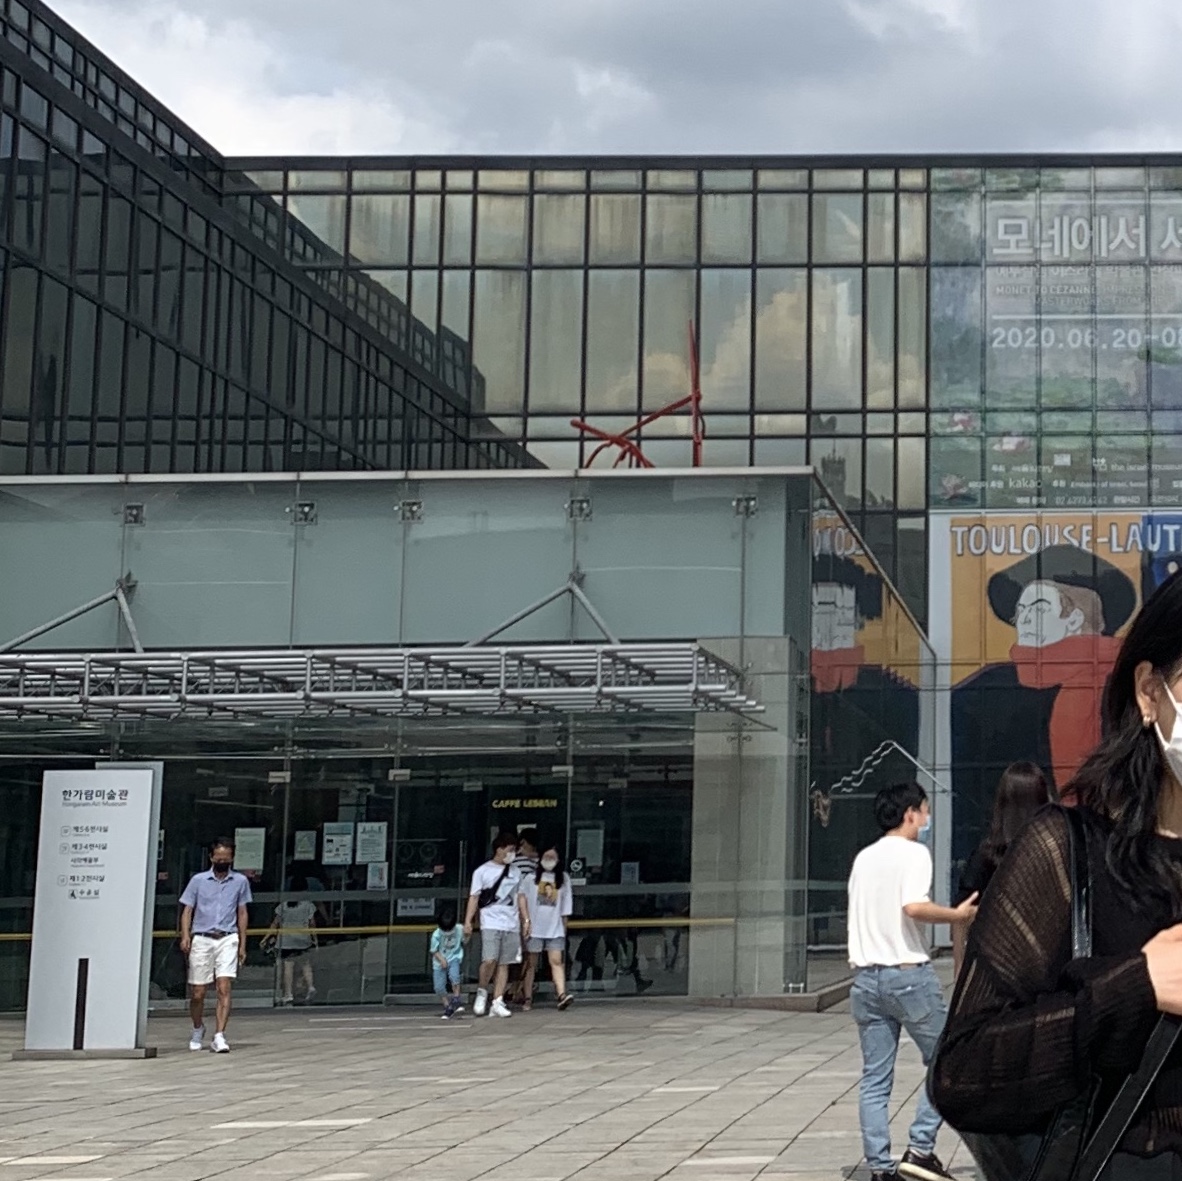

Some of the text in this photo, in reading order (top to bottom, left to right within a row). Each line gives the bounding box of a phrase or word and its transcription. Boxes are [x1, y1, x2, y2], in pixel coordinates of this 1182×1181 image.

[992, 214, 1146, 257] 모네에서
[1009, 478, 1042, 489] kakao
[62, 789, 129, 801] 한가람미술관
